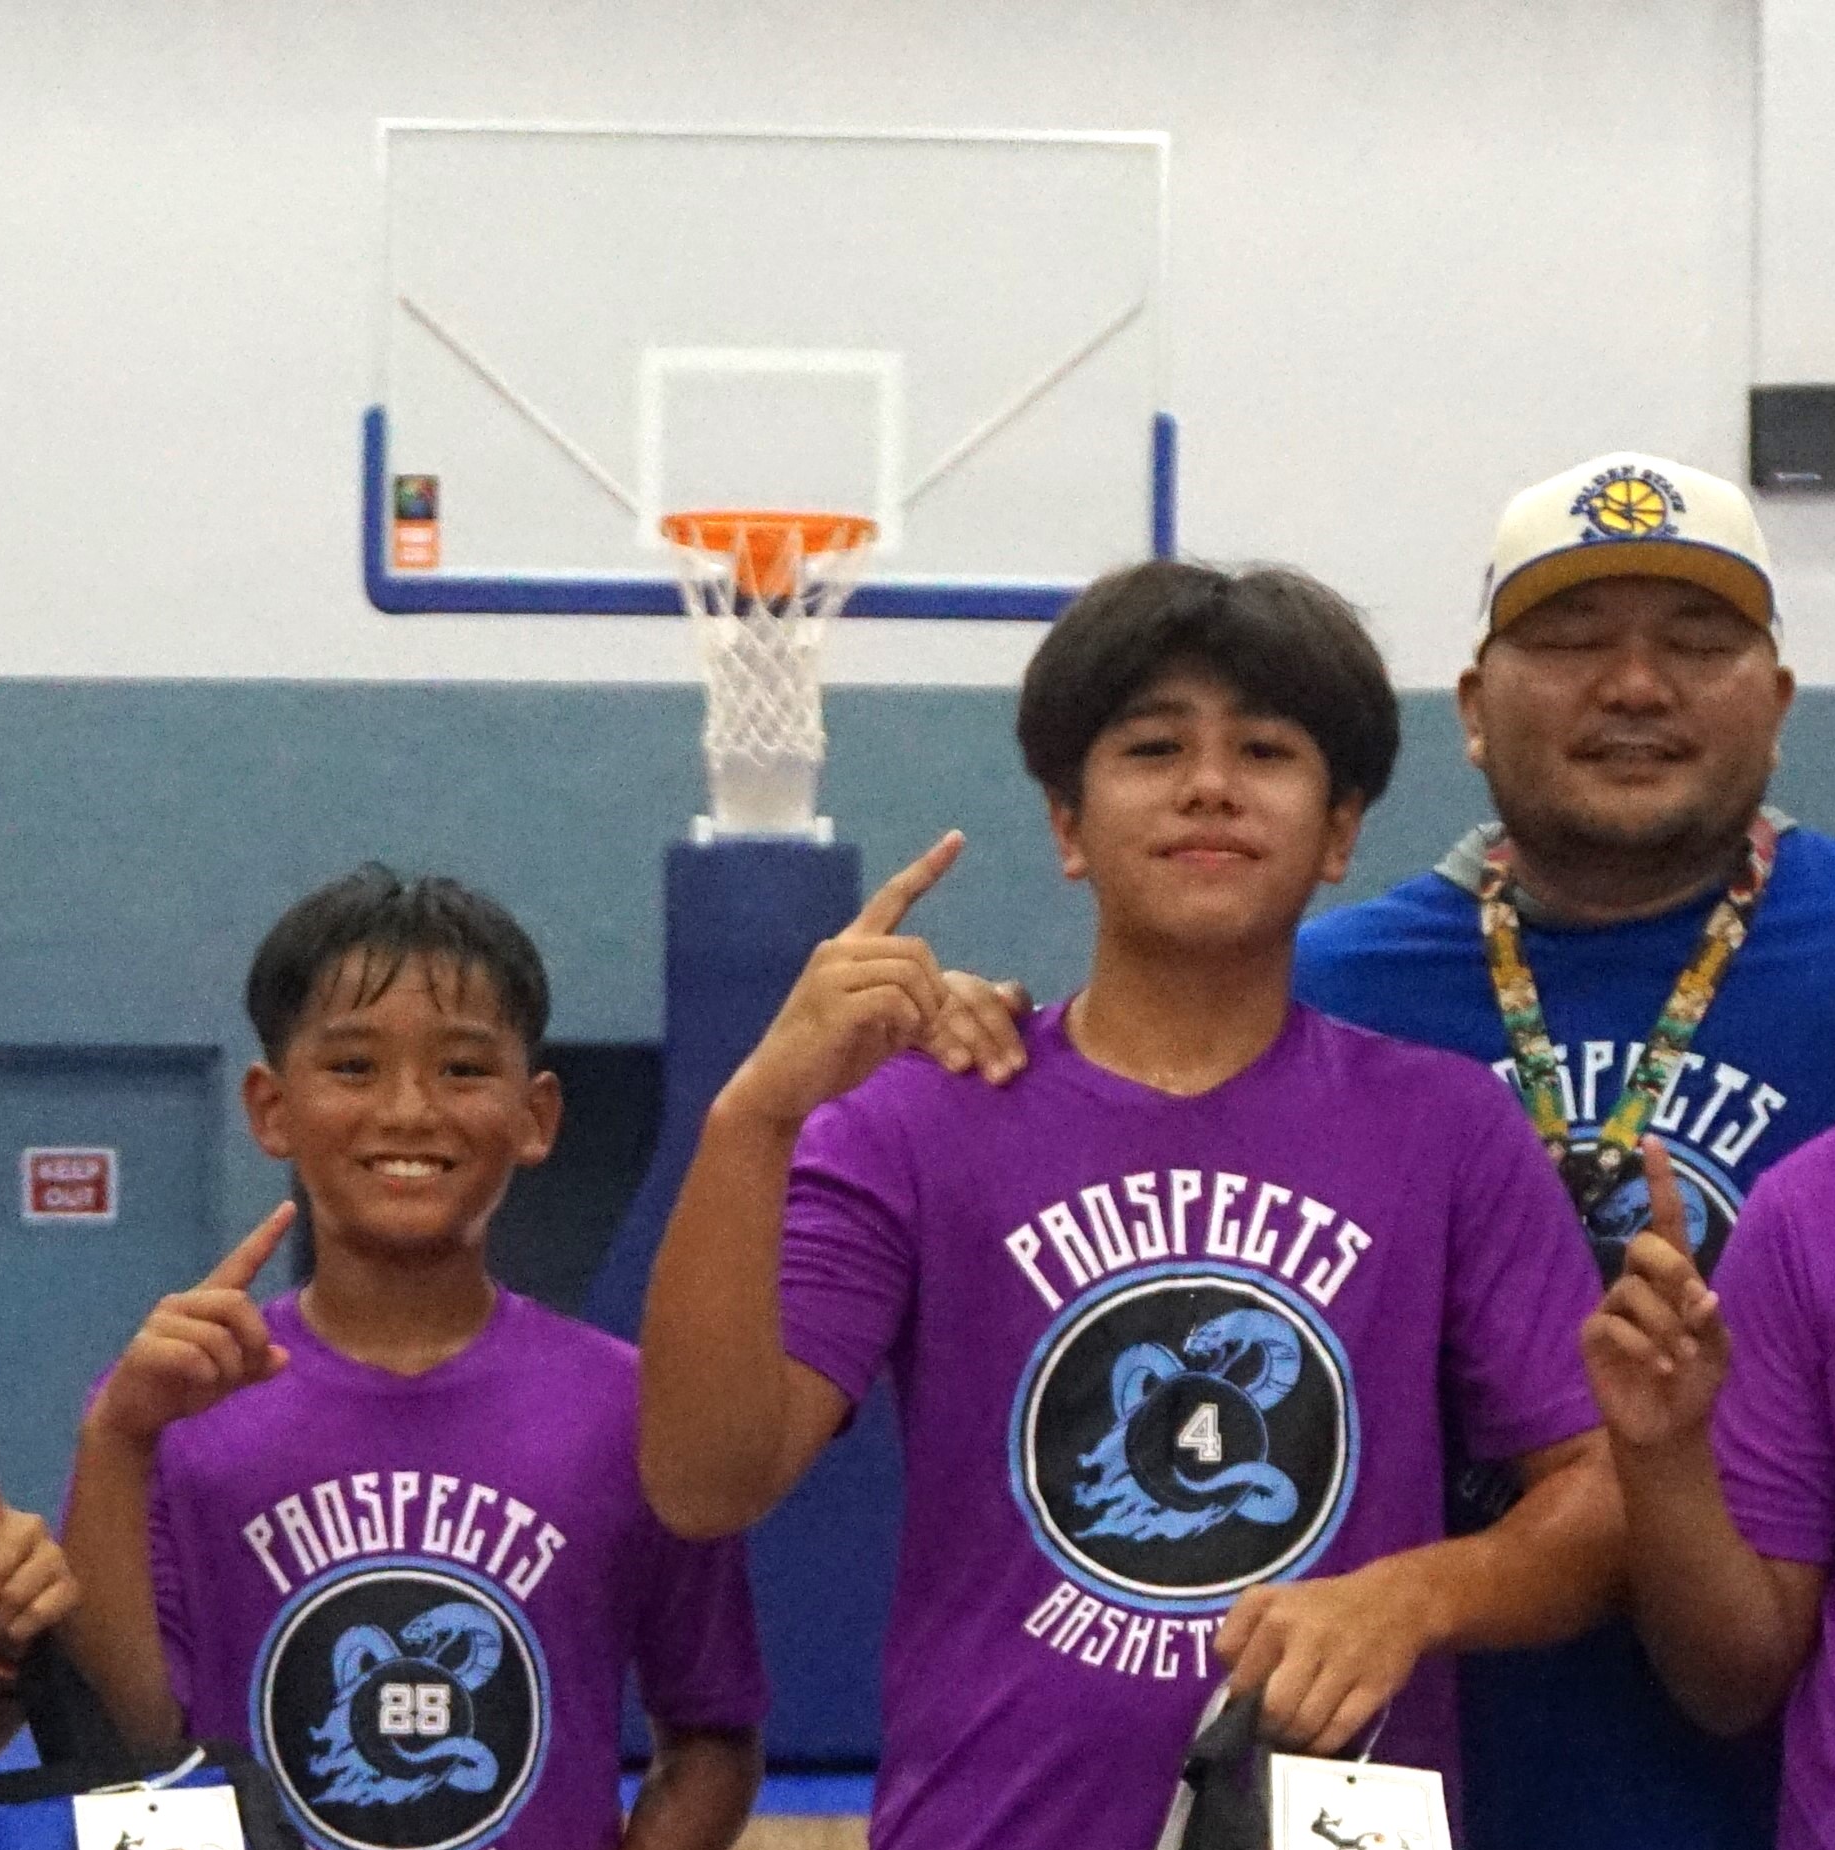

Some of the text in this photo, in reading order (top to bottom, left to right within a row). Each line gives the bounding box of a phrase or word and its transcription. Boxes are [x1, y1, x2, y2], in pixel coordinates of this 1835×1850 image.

[1004, 1168, 1373, 1312] PROSPECTS
[1177, 1403, 1222, 1462] 4
[243, 1471, 567, 1601] PROSPECTS
[1023, 1580, 1227, 1679] BASKET
[379, 1683, 451, 1735] 25
